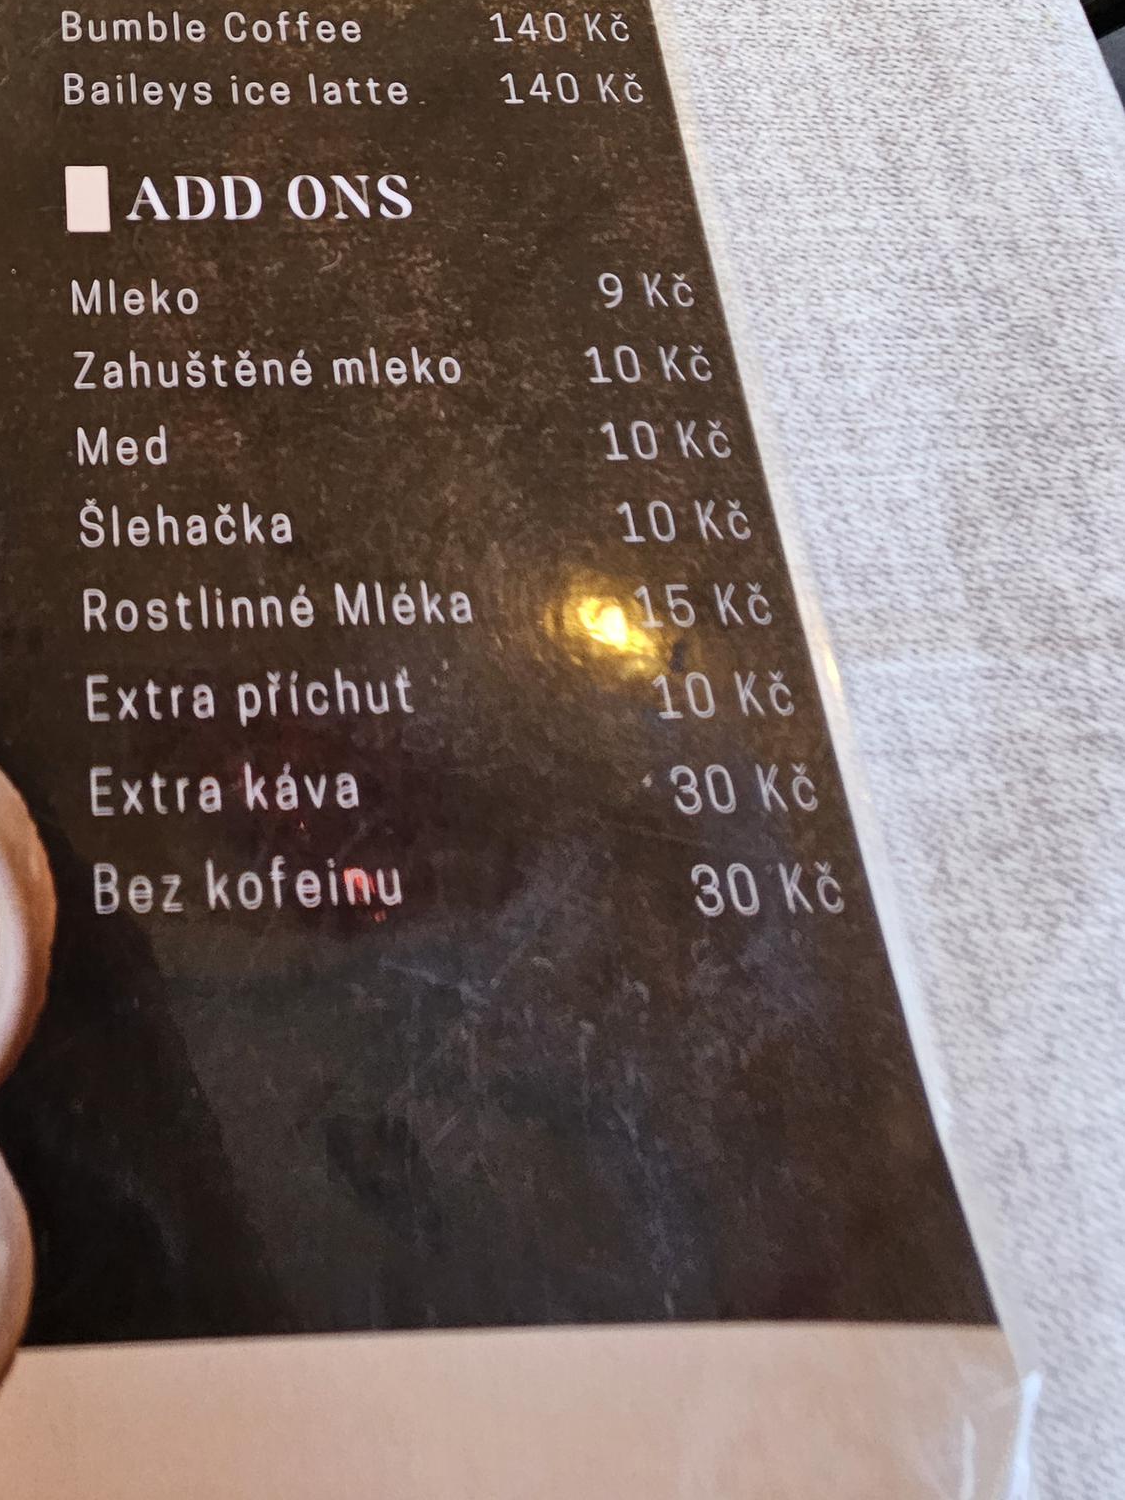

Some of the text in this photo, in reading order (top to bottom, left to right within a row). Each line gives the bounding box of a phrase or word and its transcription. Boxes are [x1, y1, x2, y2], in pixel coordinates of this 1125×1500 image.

[61, 10, 362, 43] Bumble Coffee
[489, 12, 630, 43] 140 Kč
[63, 72, 409, 111] Baileys ice latte
[499, 72, 644, 105] 140 Kč
[125, 174, 413, 221] ADD ONS
[71, 278, 199, 316] Mleko
[598, 272, 695, 309] 9 Kč
[73, 346, 462, 390] Zahuštěné mleko
[584, 345, 713, 384] 10 Kč
[76, 424, 168, 466] Med
[599, 419, 732, 461] 10 Kč
[79, 498, 293, 548] Šlehačka
[616, 499, 752, 543] 10 Kč
[82, 579, 473, 632] Rostlinné Mléka
[633, 582, 773, 628] 15 Kč
[86, 674, 215, 722] Extra
[653, 670, 795, 721] 10 Kč
[89, 762, 359, 817] Extra káva
[669, 763, 819, 815] 30 Kč
[93, 855, 403, 915] Bez kofeinu
[690, 861, 845, 917] 30 Kč
